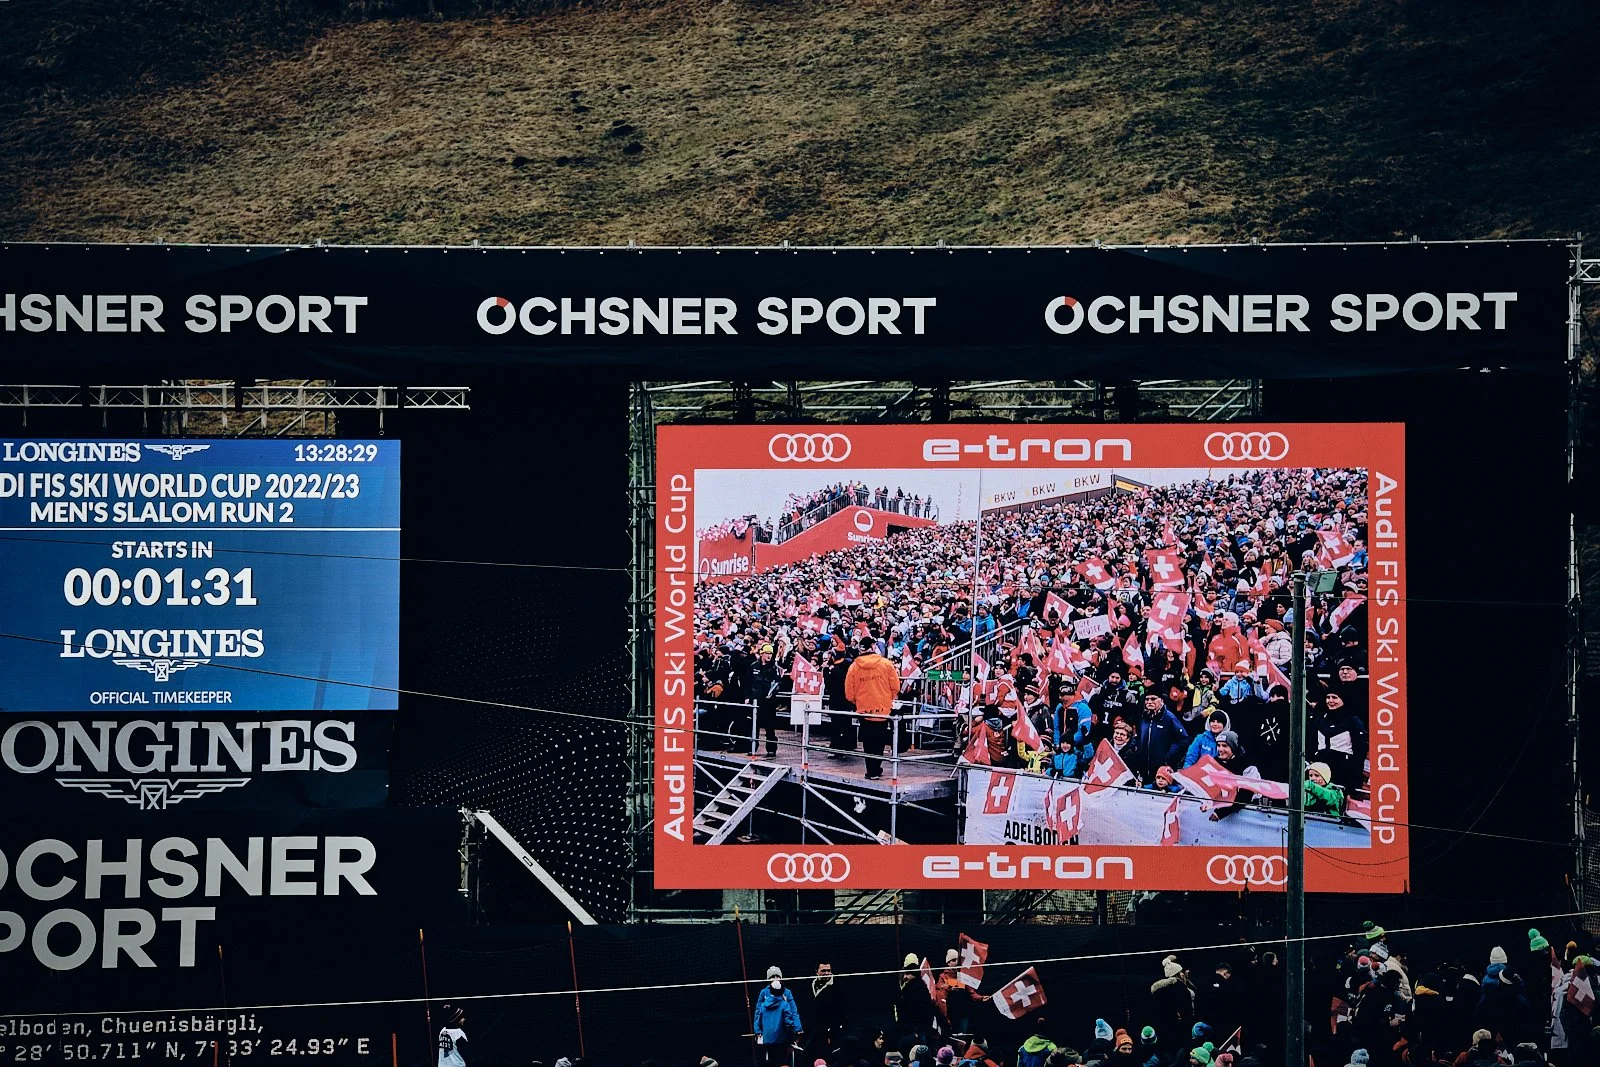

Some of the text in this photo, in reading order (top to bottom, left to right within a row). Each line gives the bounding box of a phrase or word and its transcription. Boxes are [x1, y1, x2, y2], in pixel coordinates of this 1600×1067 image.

[185, 295, 368, 334] SPORT
[477, 297, 937, 336] OCHSNER SPORT
[1045, 292, 1518, 335] OCHSNER SPORT
[3, 441, 141, 463] LONGINES
[294, 443, 378, 462] 13:28:29
[922, 434, 1132, 462] e-tron
[0, 472, 360, 499] DI FIS SKI WORLD CUP 2022/23
[1032, 483, 1056, 496] BKW
[1074, 474, 1100, 488] BKW
[30, 501, 294, 523] MEN'S SLALOM RUN 2
[111, 540, 213, 559] STARTS IN
[711, 552, 749, 574] Sunrise
[63, 567, 257, 606] 00:01:31
[60, 629, 264, 658] LONGINES
[664, 474, 692, 842] Audi FIS Ski World Cup
[1373, 471, 1400, 845] Audi FIS Ski World Cup
[89, 690, 232, 704] OFFICIAL TIMEKEEPER
[1, 720, 357, 774] ONGINES
[1004, 820, 1079, 846] ADELBODN
[0, 836, 377, 901] CHSNER
[922, 851, 1134, 880] e-tron
[357, 1037, 370, 1054] E
